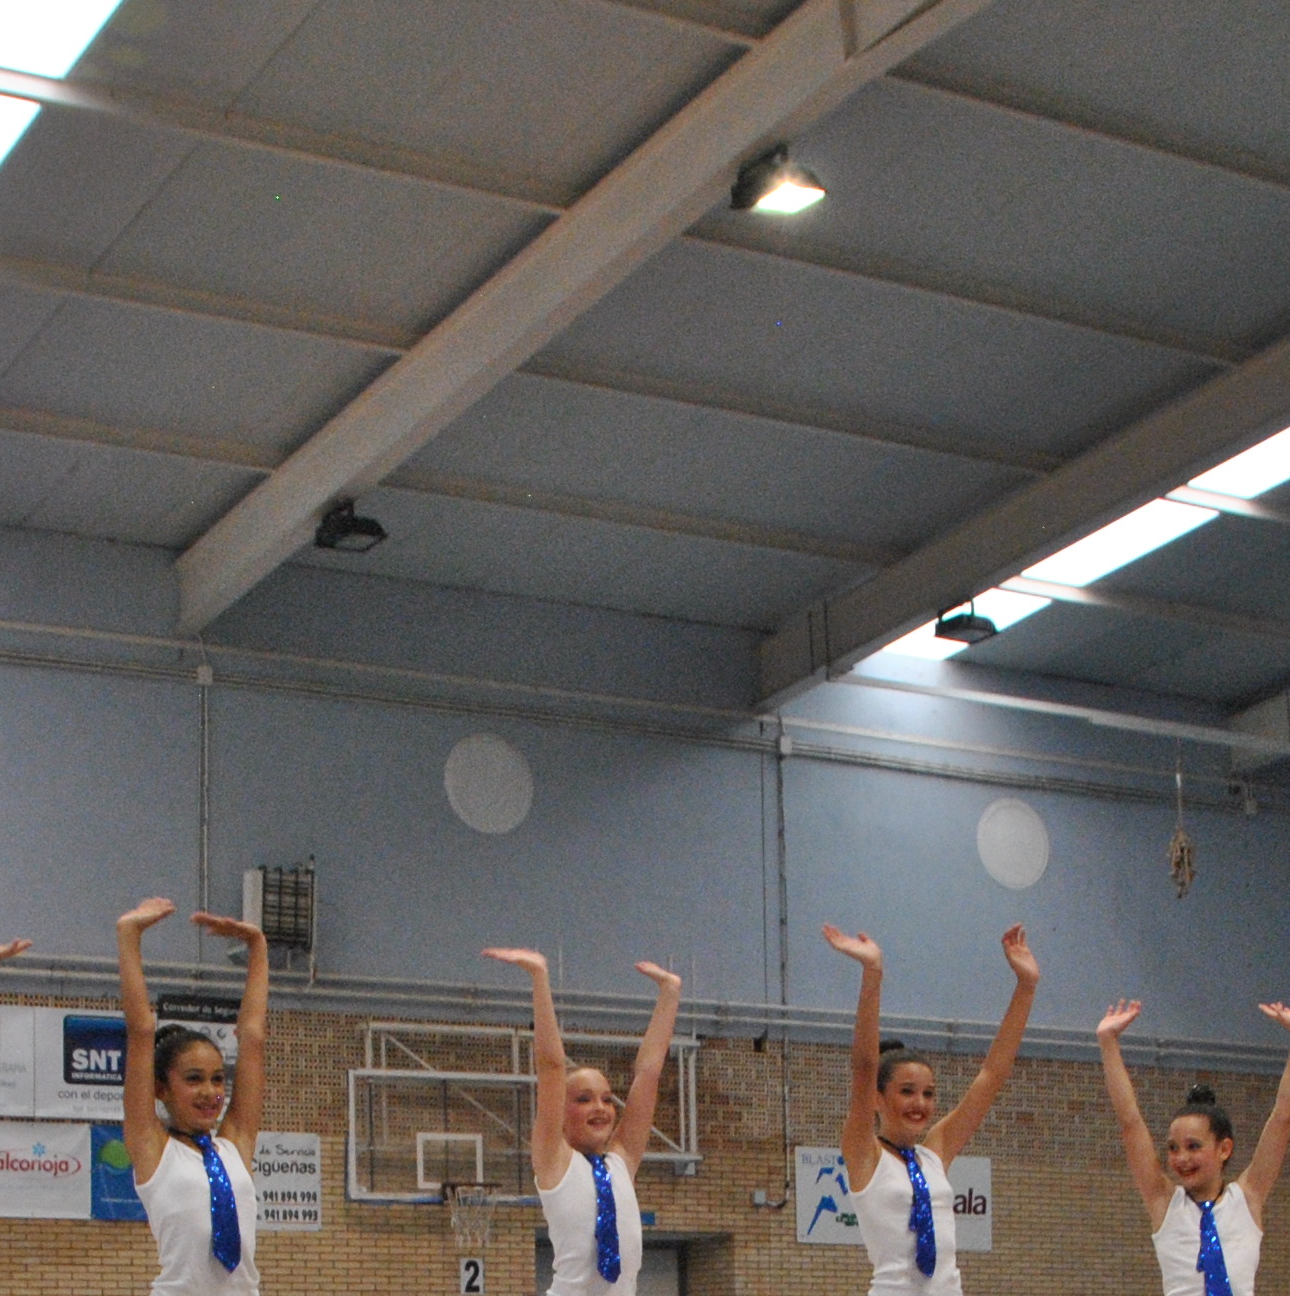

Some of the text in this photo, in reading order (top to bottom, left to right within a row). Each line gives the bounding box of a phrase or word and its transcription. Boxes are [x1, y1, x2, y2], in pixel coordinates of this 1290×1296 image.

[71, 1048, 122, 1072] SNT
[58, 1090, 78, 1100] con
[81, 1089, 91, 1100] el
[263, 1190, 278, 1202] 941
[281, 1191, 297, 1202] 894
[300, 1191, 317, 1203] 994
[953, 1187, 987, 1214] ala
[265, 1208, 280, 1221] 941
[282, 1209, 299, 1221] 894
[301, 1209, 318, 1221] 993
[464, 1259, 480, 1292] 2
